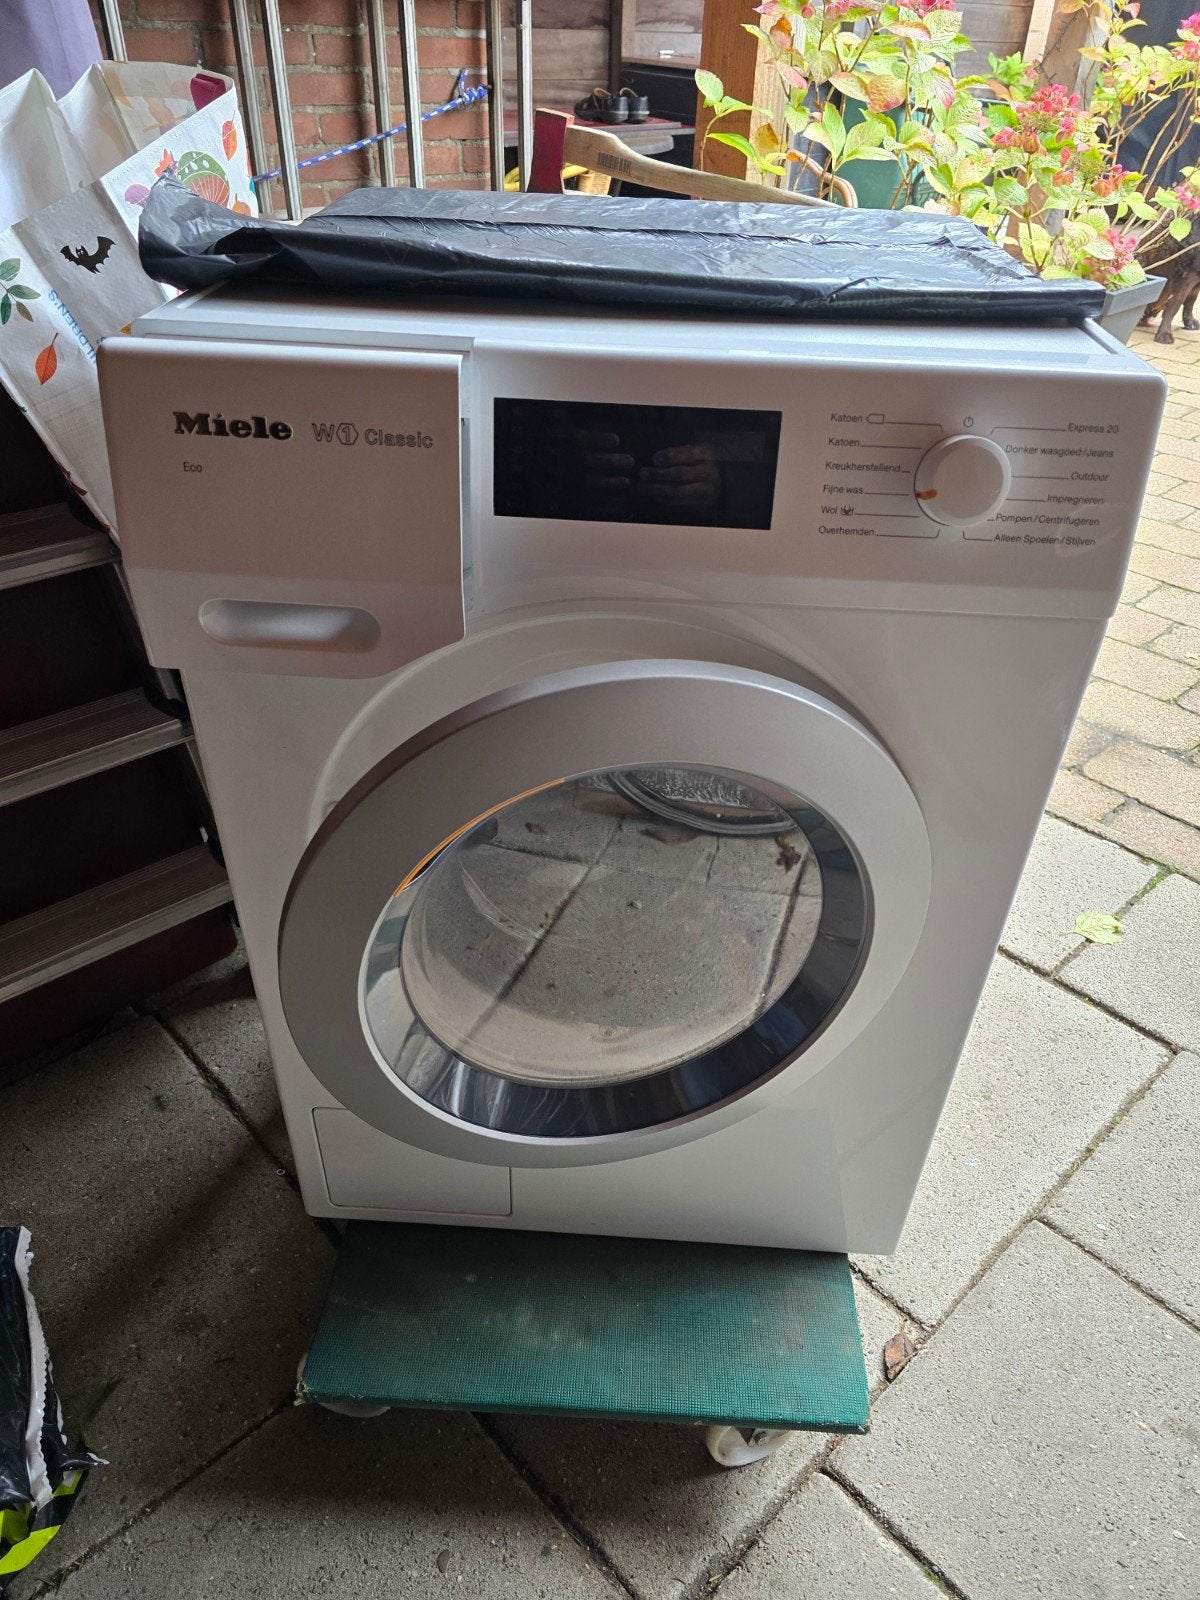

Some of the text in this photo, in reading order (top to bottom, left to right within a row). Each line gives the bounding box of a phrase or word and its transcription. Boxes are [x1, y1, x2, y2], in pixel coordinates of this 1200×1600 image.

[48, 288, 97, 364] ILDREN'S
[830, 412, 863, 423] Katoen
[173, 410, 293, 441] Miele
[364, 428, 434, 449] Classic
[1067, 422, 1120, 435] Express 20
[828, 436, 861, 448] Katoen
[1005, 444, 1039, 455] Donker
[183, 461, 203, 473] Eco
[825, 460, 901, 473] Kreukherstellend
[1070, 471, 1110, 482] Outdoor
[822, 484, 865, 495] Fijne was
[1046, 494, 1105, 506] Impregneren
[821, 505, 838, 515] Wol
[818, 525, 875, 537] Overhemden
[993, 533, 1022, 544] Alleen
